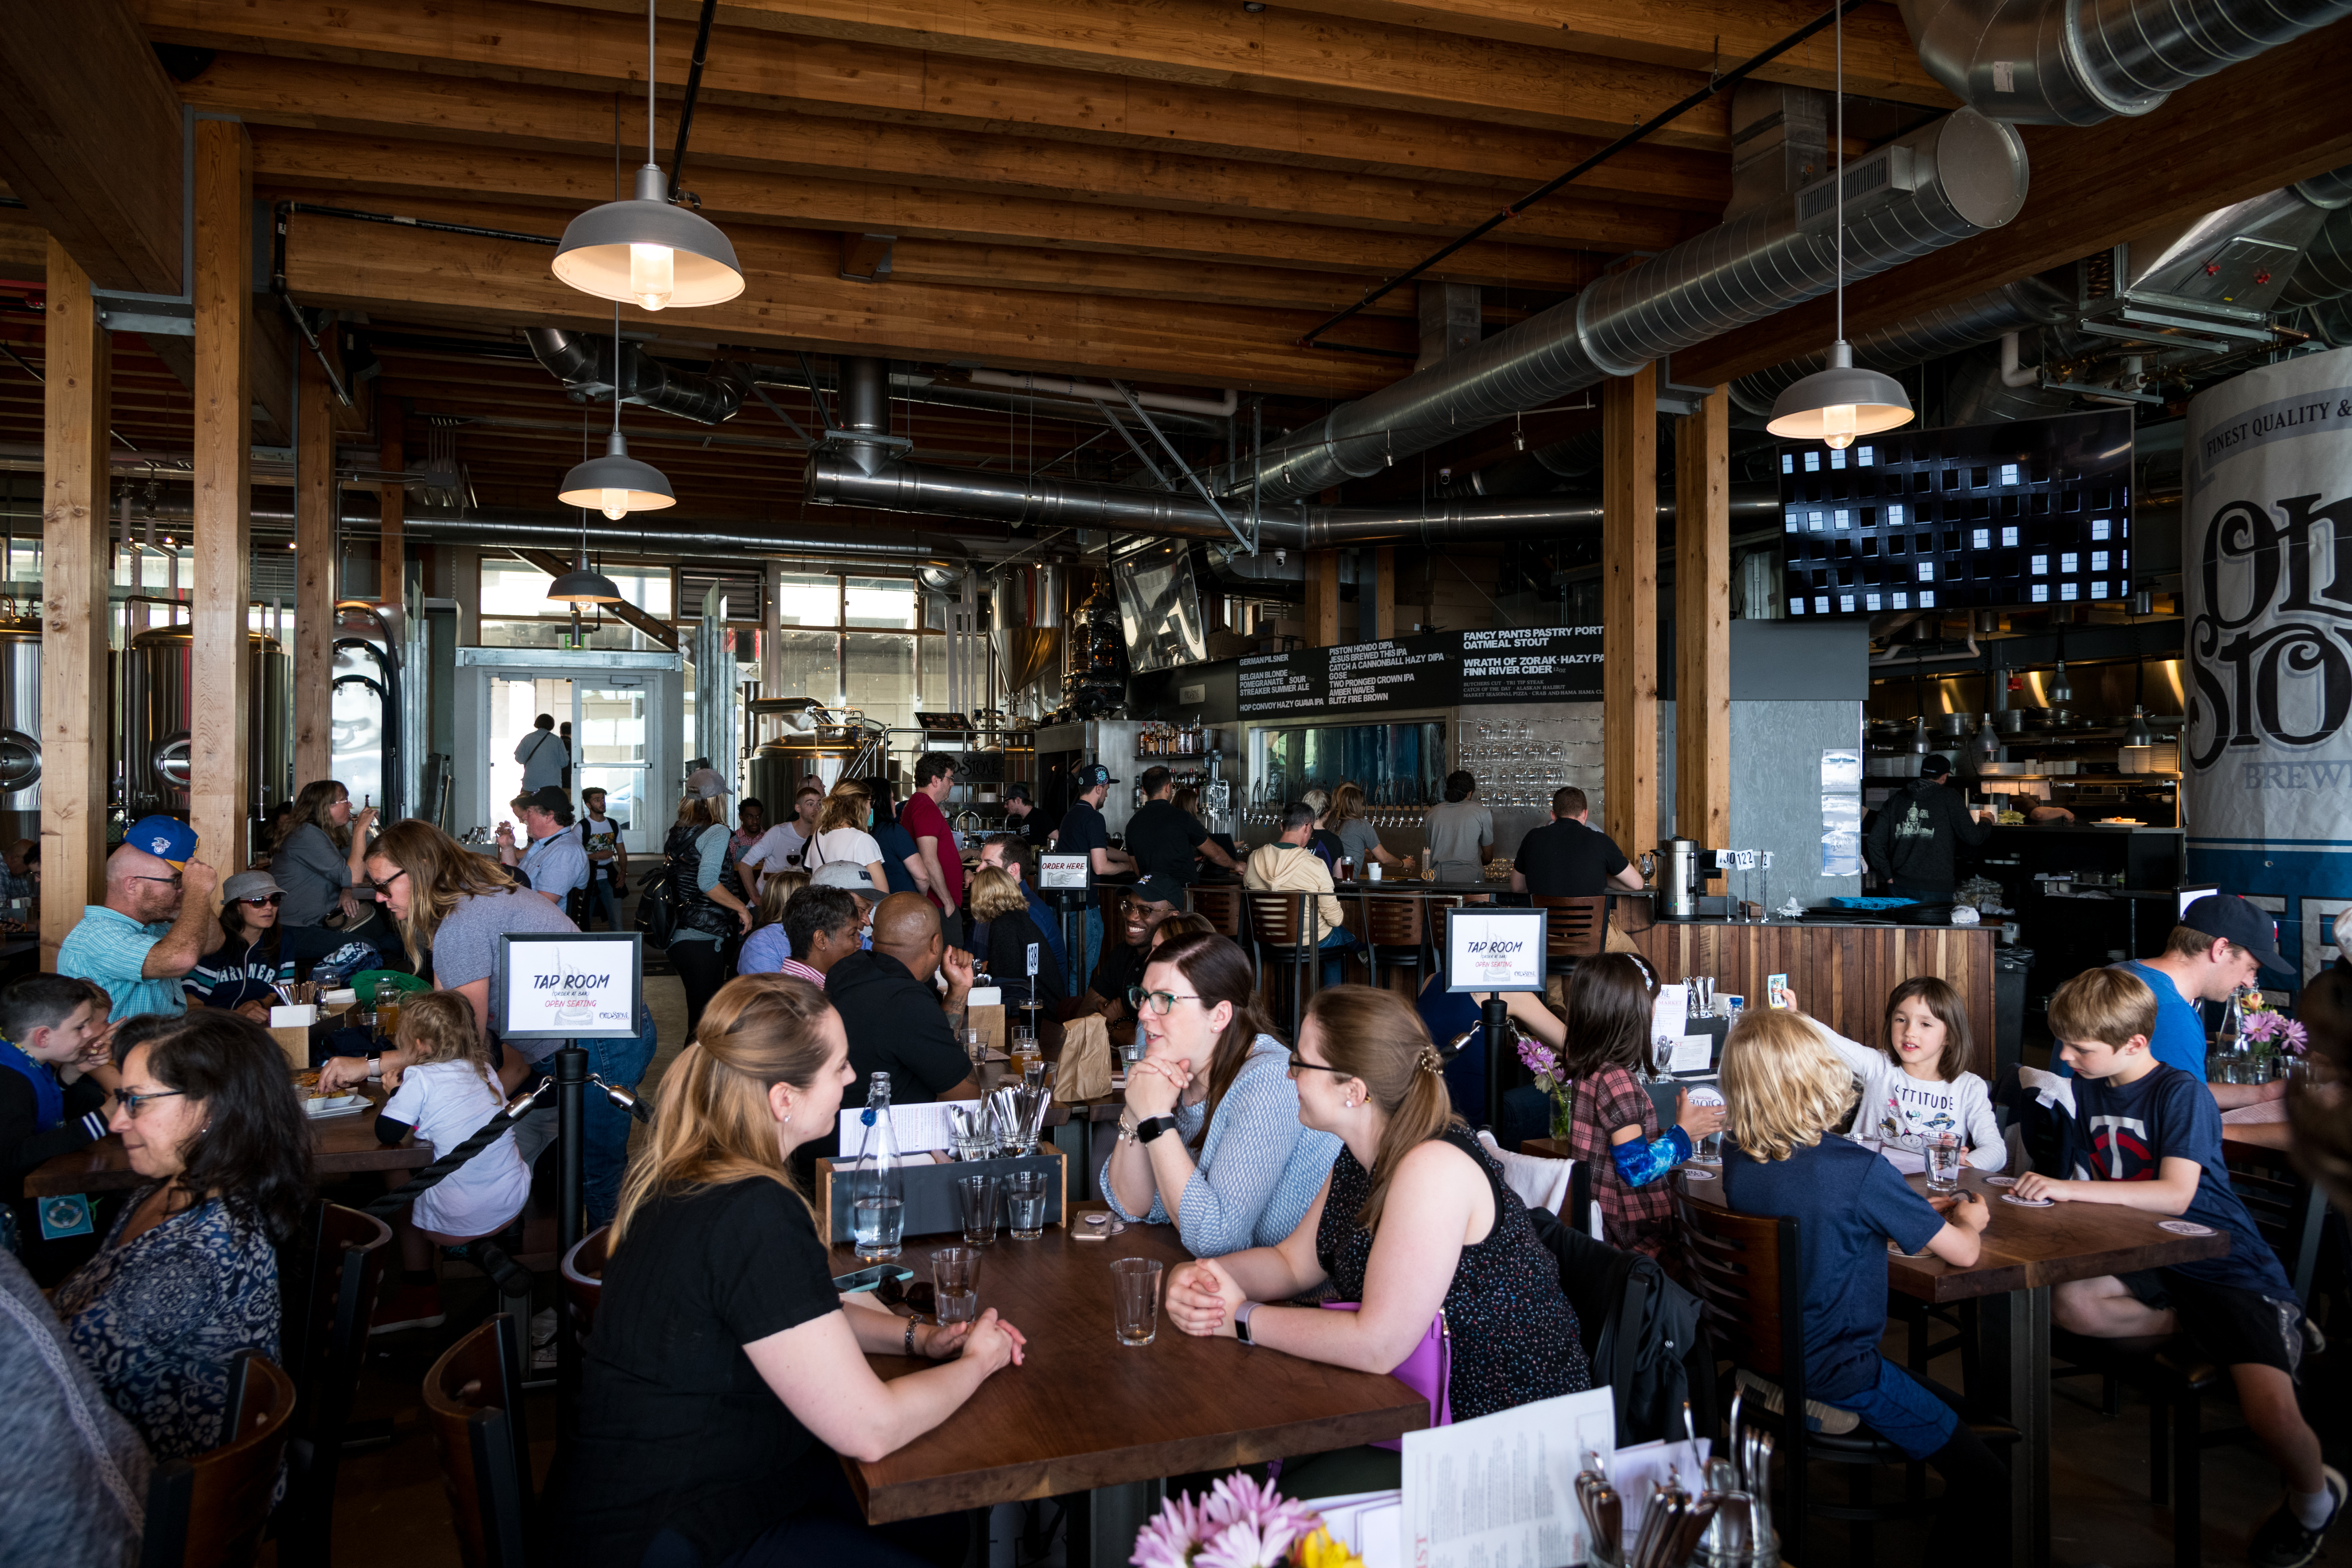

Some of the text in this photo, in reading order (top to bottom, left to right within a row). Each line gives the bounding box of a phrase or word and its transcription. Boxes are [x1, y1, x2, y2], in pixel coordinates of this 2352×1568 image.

[2207, 399, 2352, 457] FINEST QUALITY &
[1464, 626, 1604, 641] FANCY PANTS PASTRY PORT
[565, 635, 585, 648] ET
[1464, 638, 1549, 650] OATMEAL STOUT
[1329, 646, 1353, 656] PISTON
[1354, 643, 1377, 653] HONDO
[1378, 641, 1394, 650] DIPA
[1239, 654, 1288, 666] GERMAN PILSNER
[1329, 648, 1407, 664] JESUS BREWED THIS IPA
[1329, 663, 1350, 672] CATCH
[1358, 657, 1404, 669] CANNONBALL
[1405, 654, 1426, 664] HAZY
[1428, 653, 1444, 662] DIPA
[1464, 658, 1501, 667] WRATH
[1503, 657, 1517, 665] OF
[1561, 654, 1592, 664] HAZY
[1593, 654, 1604, 662] PA
[1240, 672, 1263, 681] BELGIAN
[1265, 669, 1288, 678] BLONDE
[1329, 672, 1347, 680] GOSE
[1464, 667, 1486, 676] FINN
[1489, 666, 1520, 675] RIVER
[1522, 665, 1552, 674] CIDER
[1240, 678, 1283, 689] POMEGRANATE
[1289, 675, 1306, 684] SOUR
[1329, 680, 1344, 688] TWO
[1345, 677, 1376, 687] PRONGED
[1377, 675, 1402, 684] CROWN
[1240, 687, 1270, 696] STREAKER
[1271, 684, 1296, 693] SUMMER
[1329, 686, 1375, 696] AMBER WAVES
[2189, 613, 2352, 770] STO
[1252, 702, 1276, 710] CONVOY
[1277, 700, 1294, 708] HAZY
[1295, 699, 1314, 707] GUAVA
[1329, 693, 1388, 705] BLITZ FIRE BROWN
[960, 757, 999, 776] STOVE
[1737, 852, 1753, 865] 122
[1468, 942, 1523, 953] TAP ROOM
[1029, 946, 1037, 967] 138
[534, 974, 610, 989] TAP ROOM
[1657, 988, 1670, 997] OVE
